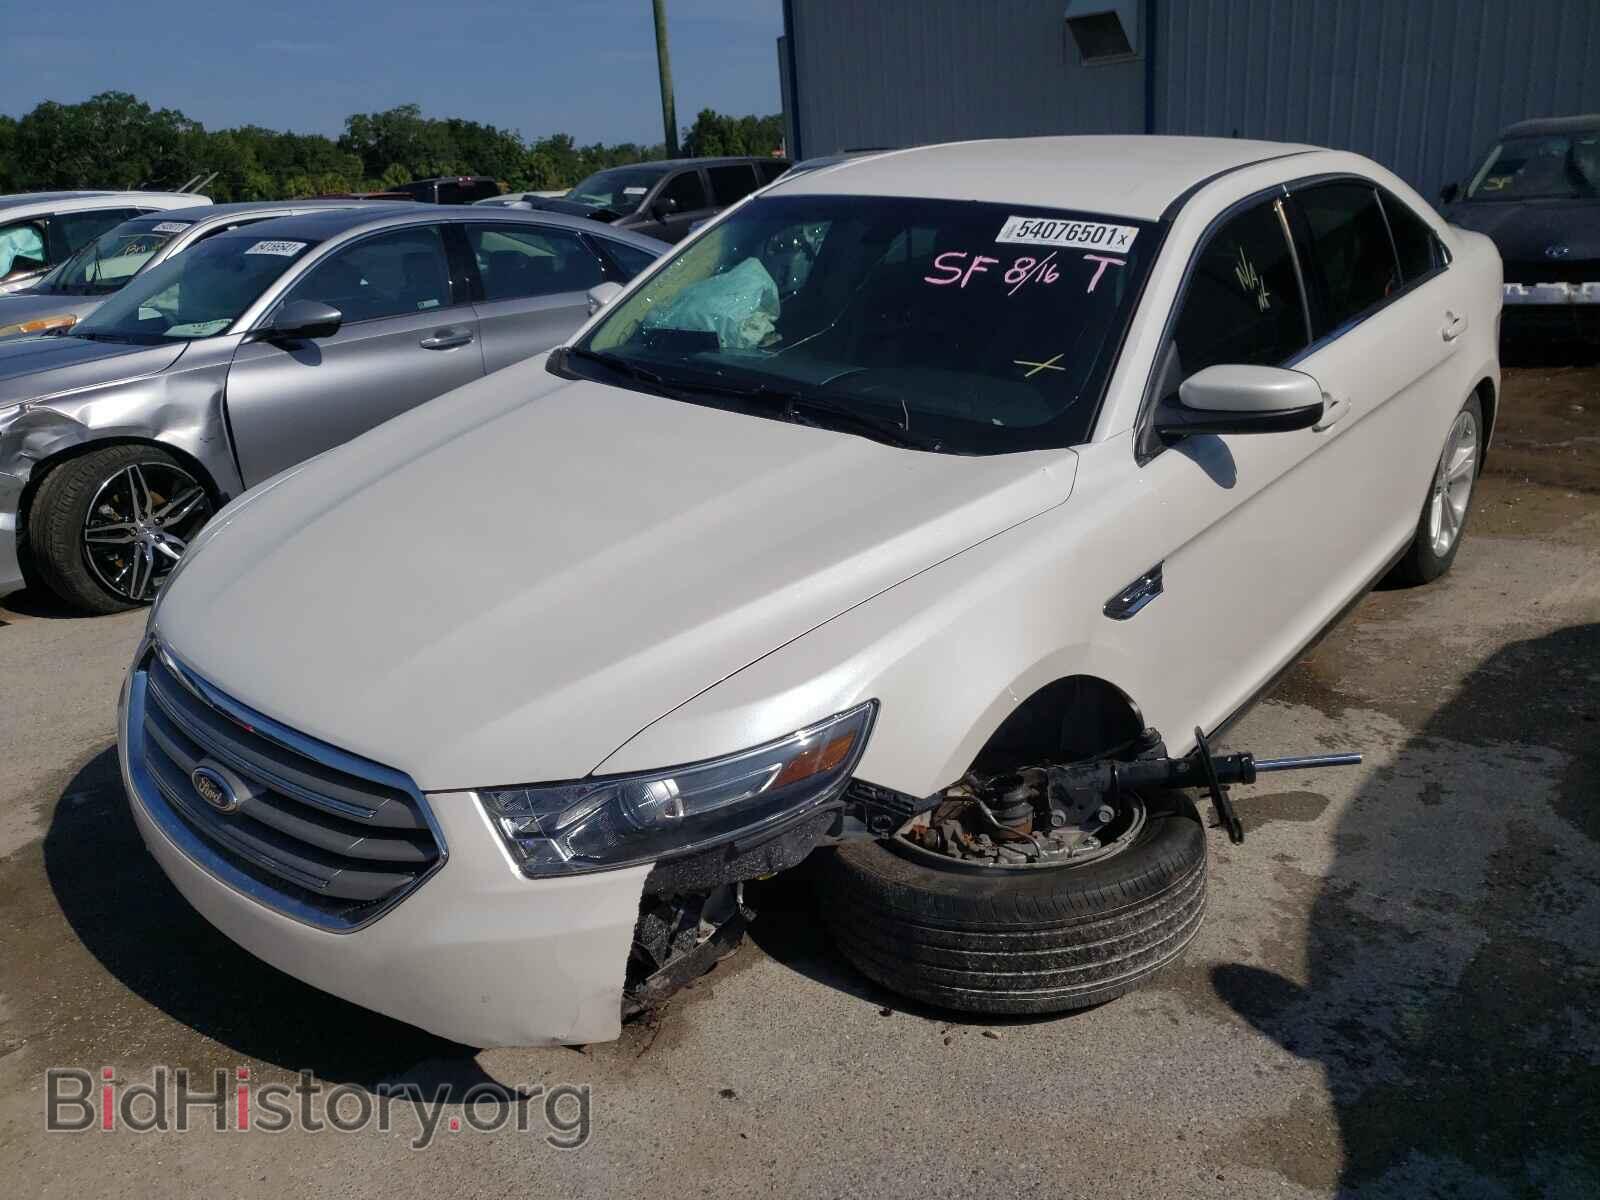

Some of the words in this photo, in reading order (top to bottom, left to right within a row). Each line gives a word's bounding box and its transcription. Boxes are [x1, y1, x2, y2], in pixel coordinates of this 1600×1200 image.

[924, 252, 999, 288] SF
[1004, 250, 1060, 296] 8/16
[1082, 254, 1127, 294] T
